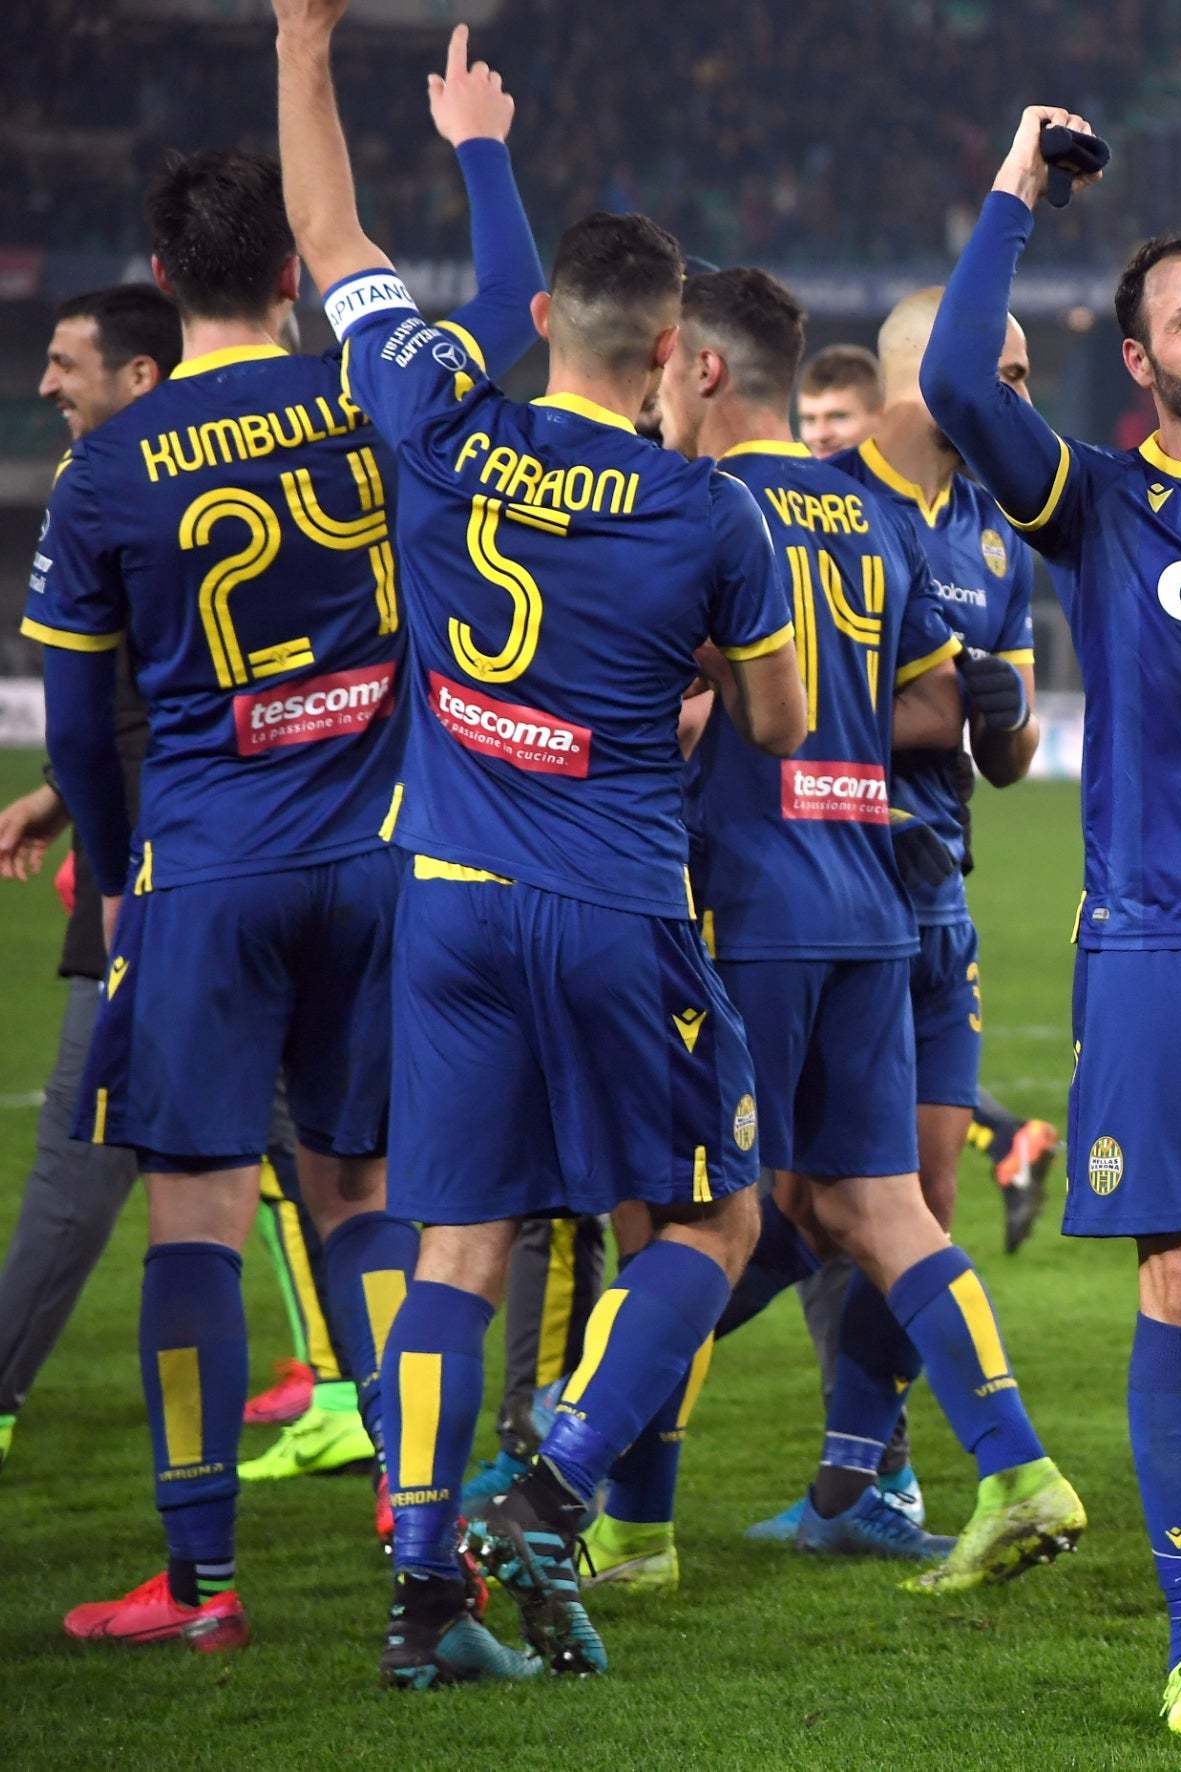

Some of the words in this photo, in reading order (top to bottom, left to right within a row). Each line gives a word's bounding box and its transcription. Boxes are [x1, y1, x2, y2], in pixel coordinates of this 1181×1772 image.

[454, 432, 640, 515] FARAONI
[764, 487, 869, 534] VERRE
[179, 447, 399, 689] 24
[448, 494, 571, 684] 5
[786, 546, 885, 732] 14
[439, 686, 575, 752] tescoma
